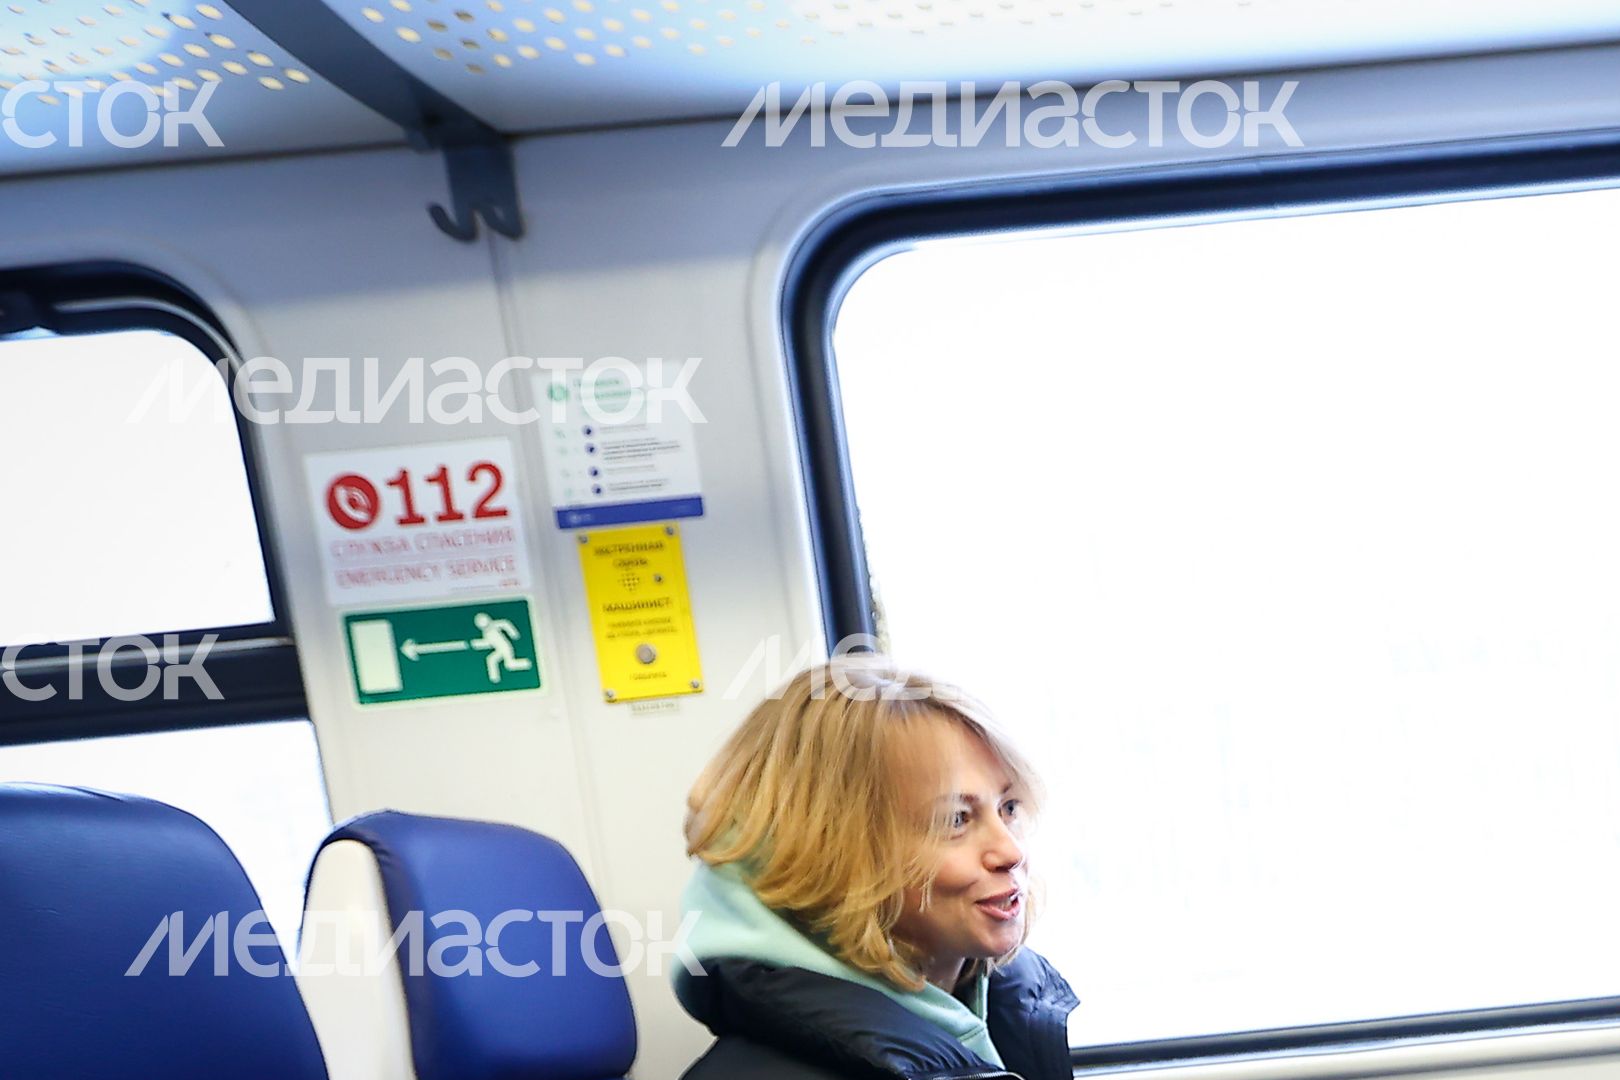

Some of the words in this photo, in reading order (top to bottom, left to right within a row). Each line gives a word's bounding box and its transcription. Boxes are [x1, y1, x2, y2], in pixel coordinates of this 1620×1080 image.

[384, 460, 509, 526] 112
[335, 563, 441, 589] EMERGENCY
[445, 555, 516, 577] SERVICE
